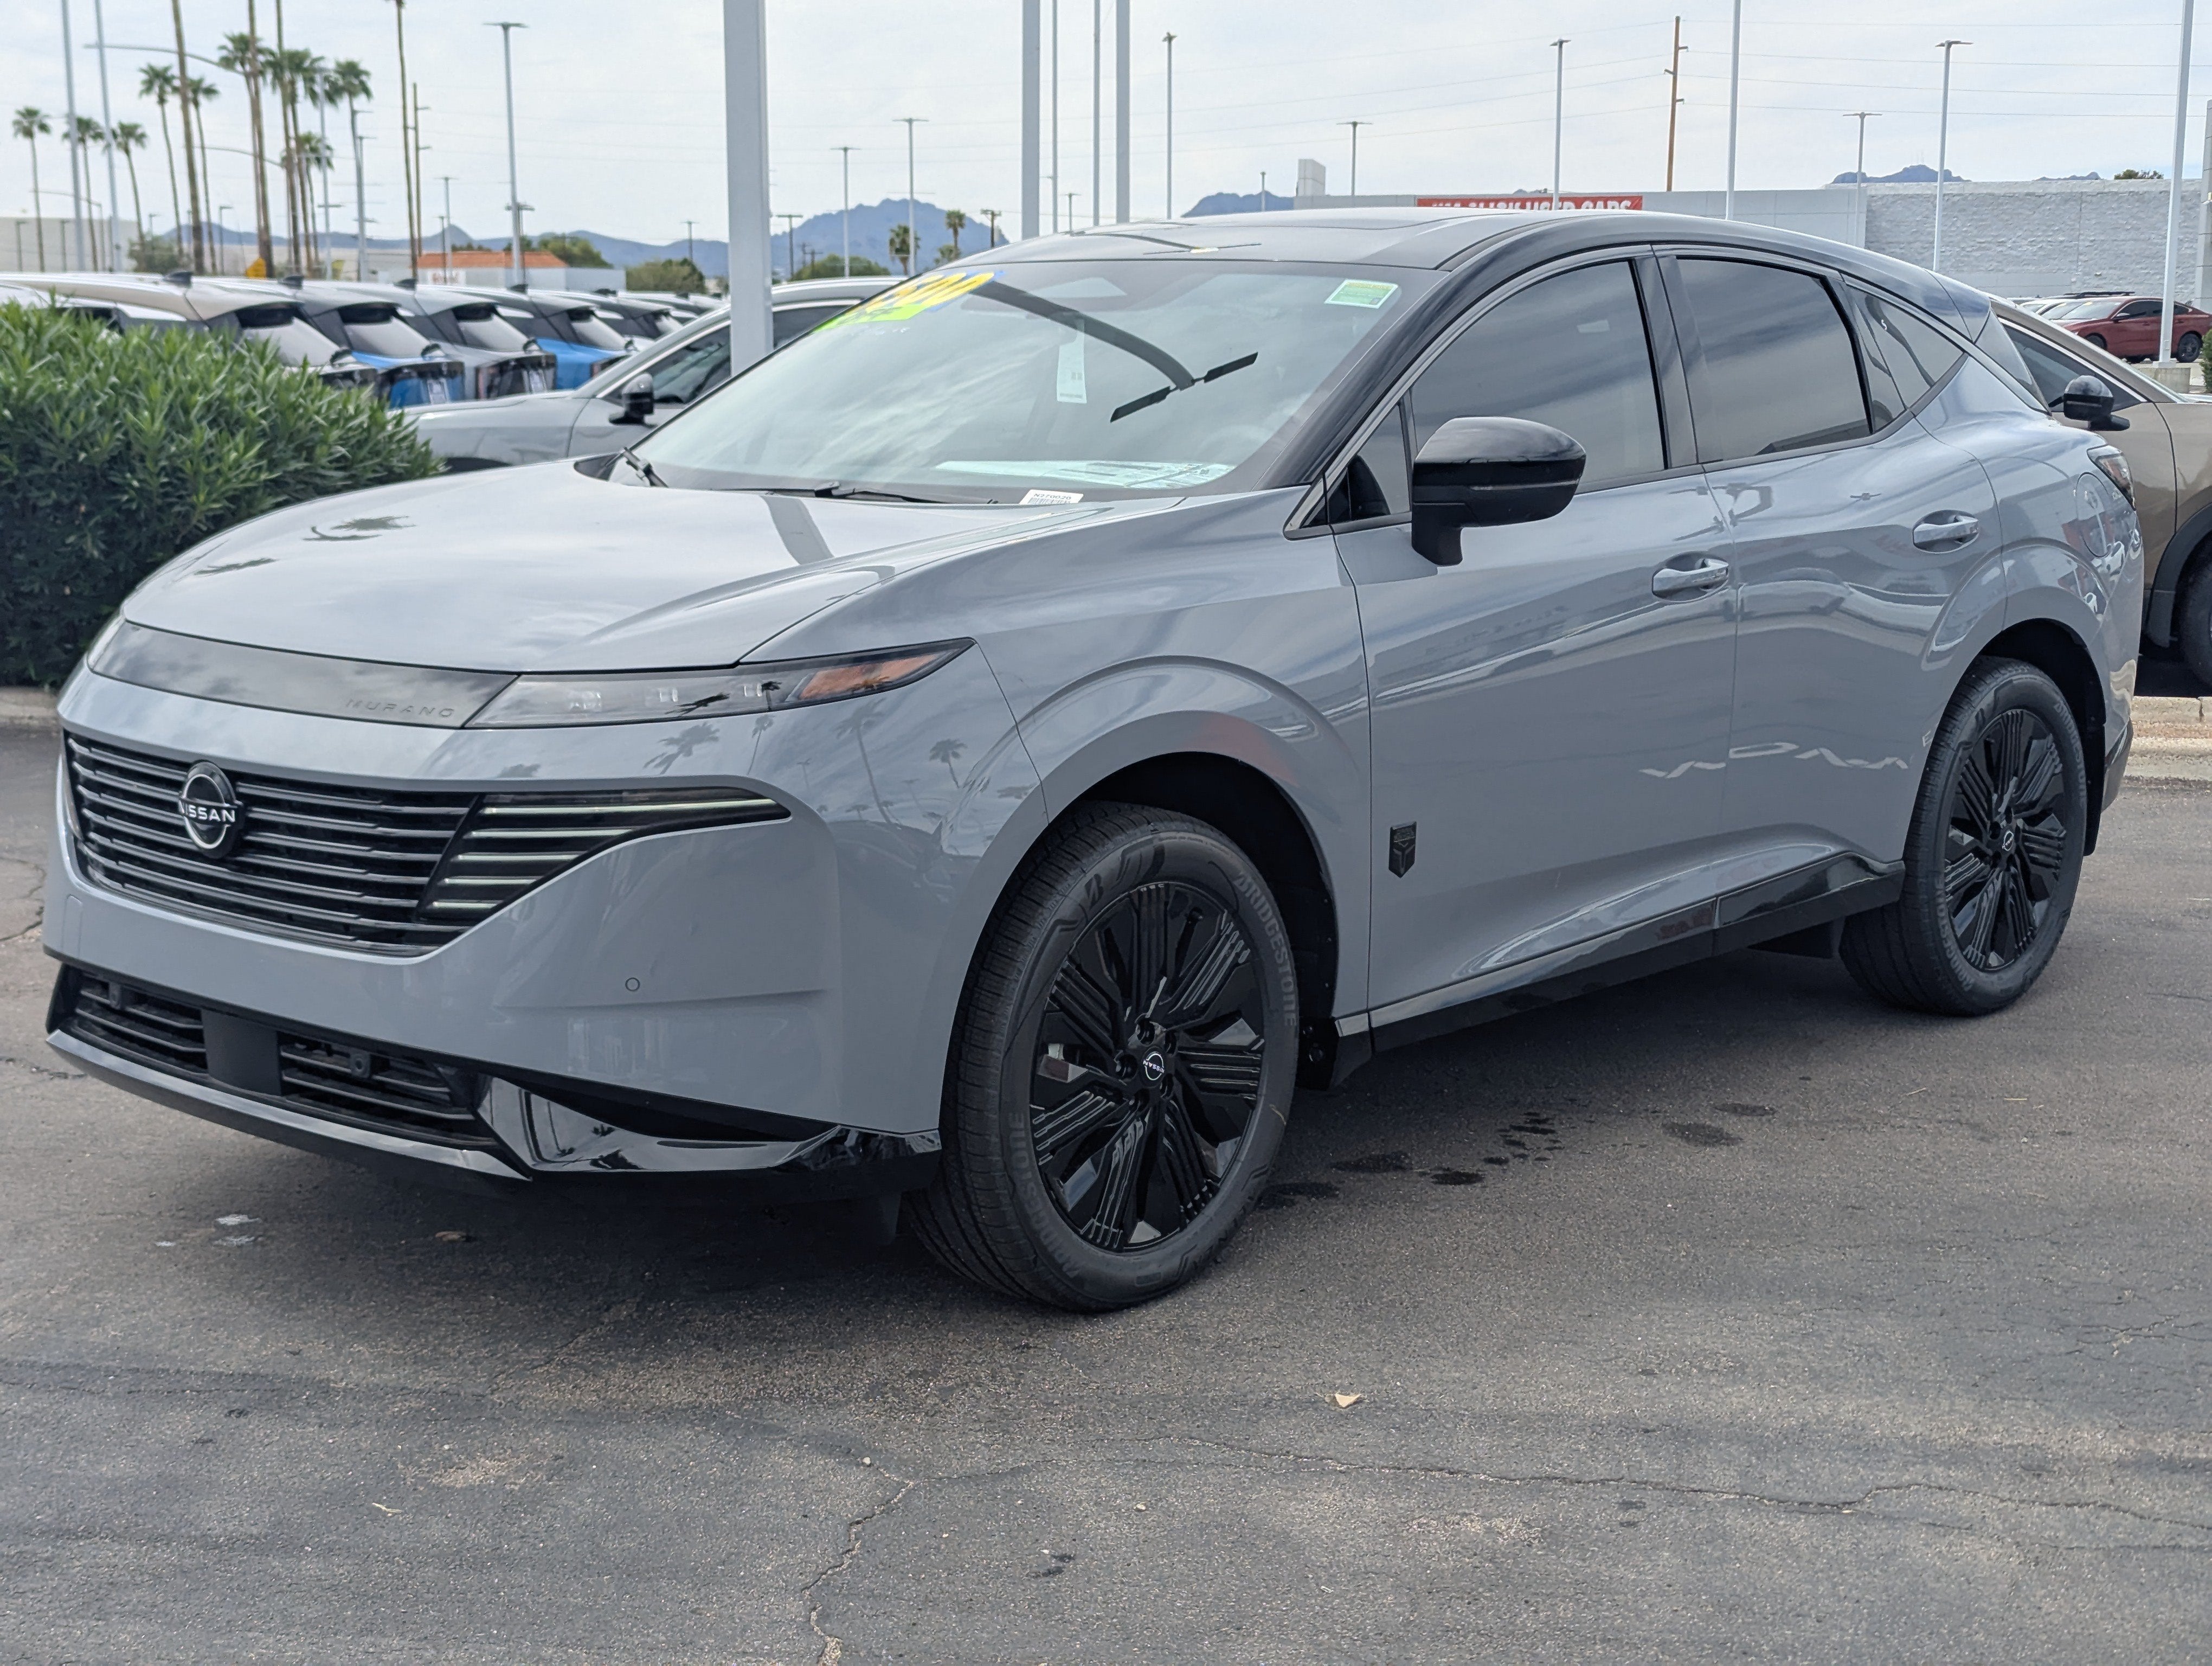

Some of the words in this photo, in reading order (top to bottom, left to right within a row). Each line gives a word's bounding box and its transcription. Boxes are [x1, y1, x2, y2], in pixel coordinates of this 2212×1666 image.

[1526, 201, 1576, 210] USD
[345, 699, 455, 718] MURANO
[178, 799, 236, 823] NISSAN
[1233, 871, 1298, 1027] BRIDGESTONE
